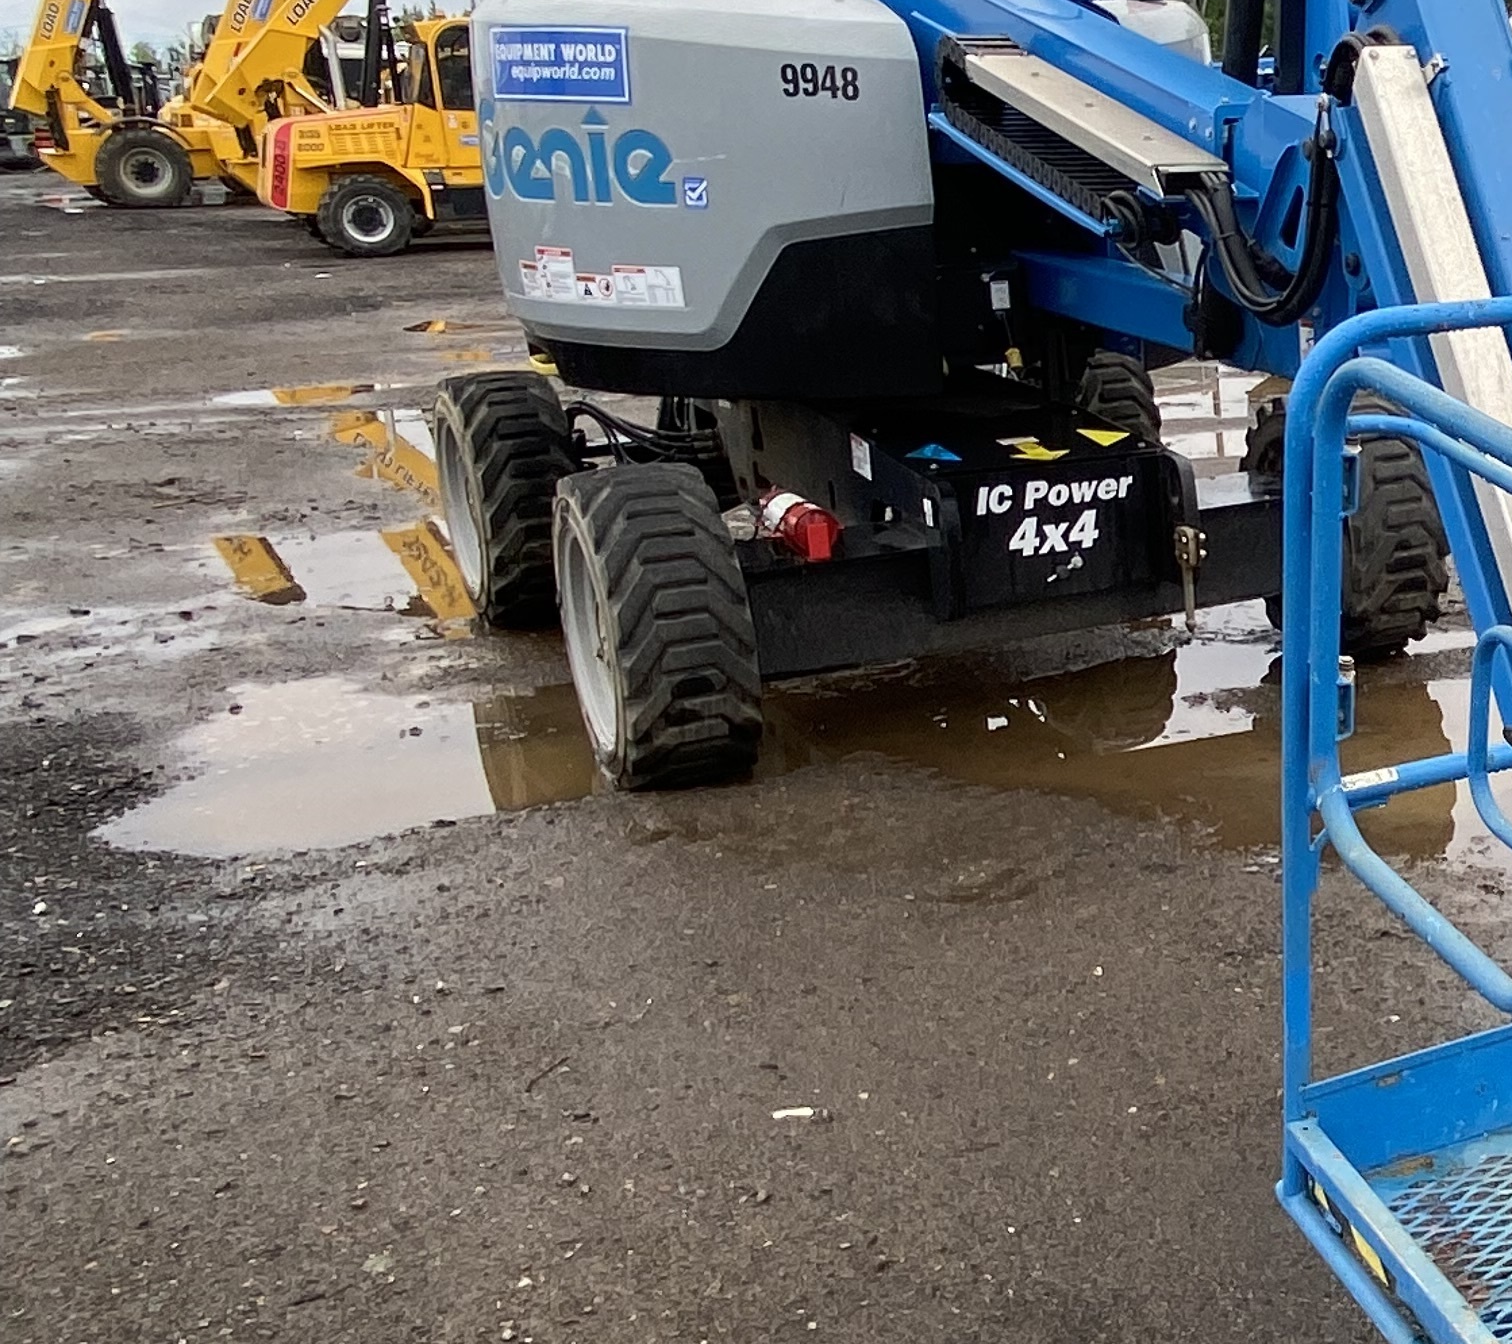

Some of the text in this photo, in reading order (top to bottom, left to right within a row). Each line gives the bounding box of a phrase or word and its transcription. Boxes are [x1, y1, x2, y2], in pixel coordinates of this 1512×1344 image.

[40, 4, 60, 41] LOAD
[495, 43, 617, 63] EQUIPMENT WORLD
[510, 62, 616, 83] equipworld.com
[780, 62, 860, 102] 9948
[976, 475, 1134, 516] IC Power
[1008, 509, 1100, 557] 4x4
